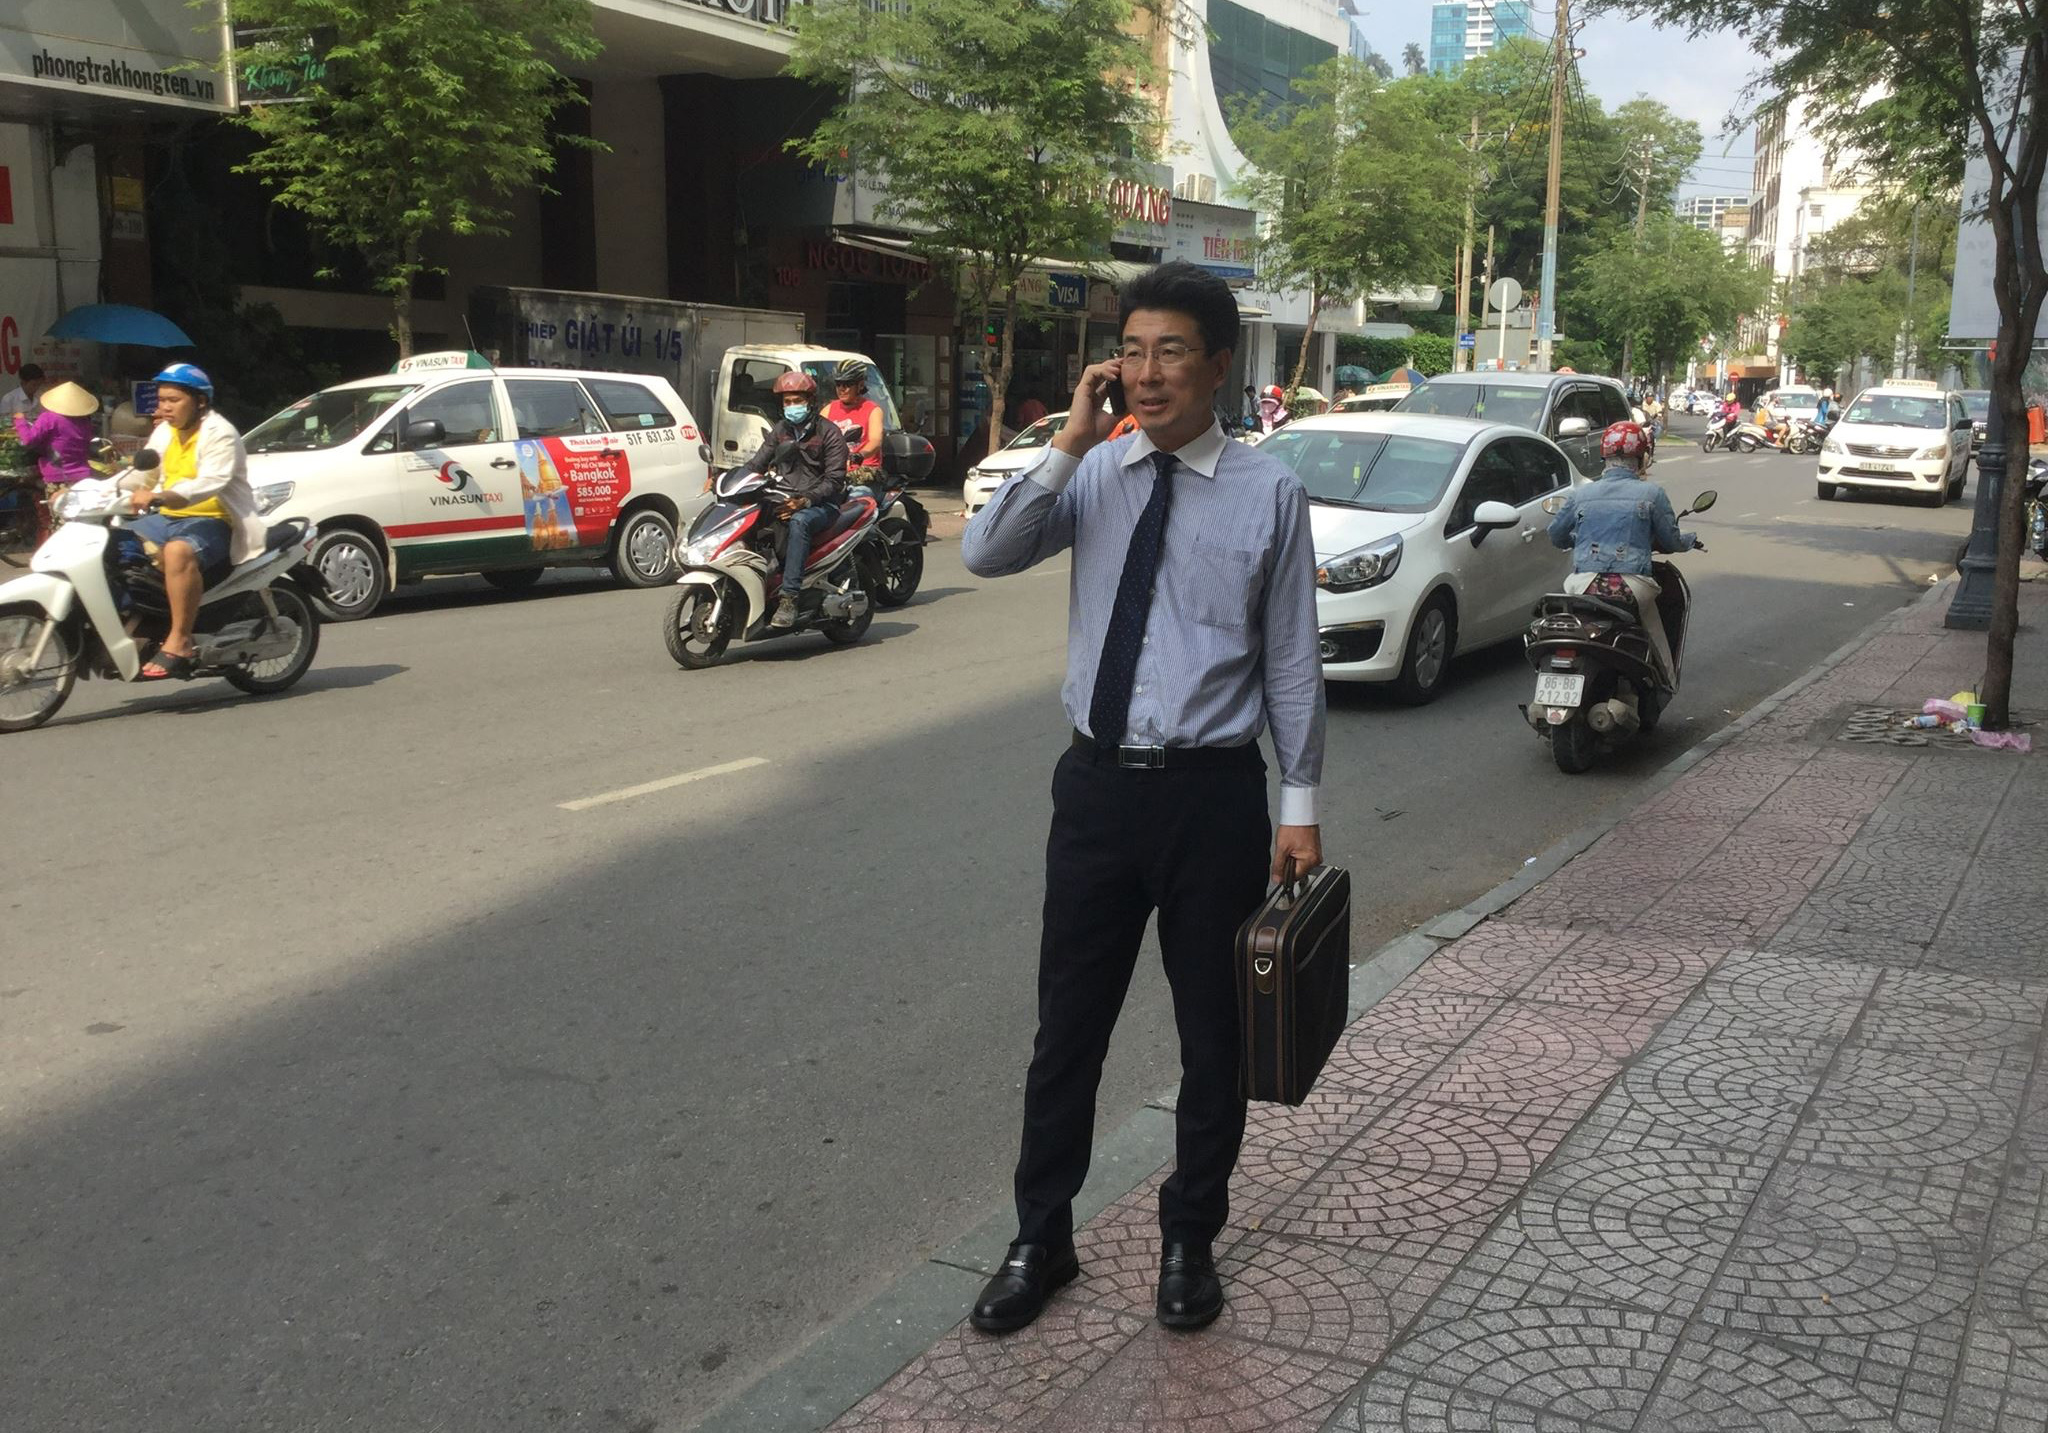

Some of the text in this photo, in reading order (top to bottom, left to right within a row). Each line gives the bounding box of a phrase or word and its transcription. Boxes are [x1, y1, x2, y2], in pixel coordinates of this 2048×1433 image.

[1057, 286, 1080, 304] VISA
[565, 314, 615, 358] GIẶT
[654, 328, 683, 362] 1/5
[415, 356, 466, 369] VINASUN TAXI
[626, 428, 676, 446] 51F 631.33
[570, 467, 616, 484] Bangkok
[577, 485, 611, 498] 585,000
[1544, 676, 1577, 690] 86-B8
[1537, 690, 1579, 705] 212.92
